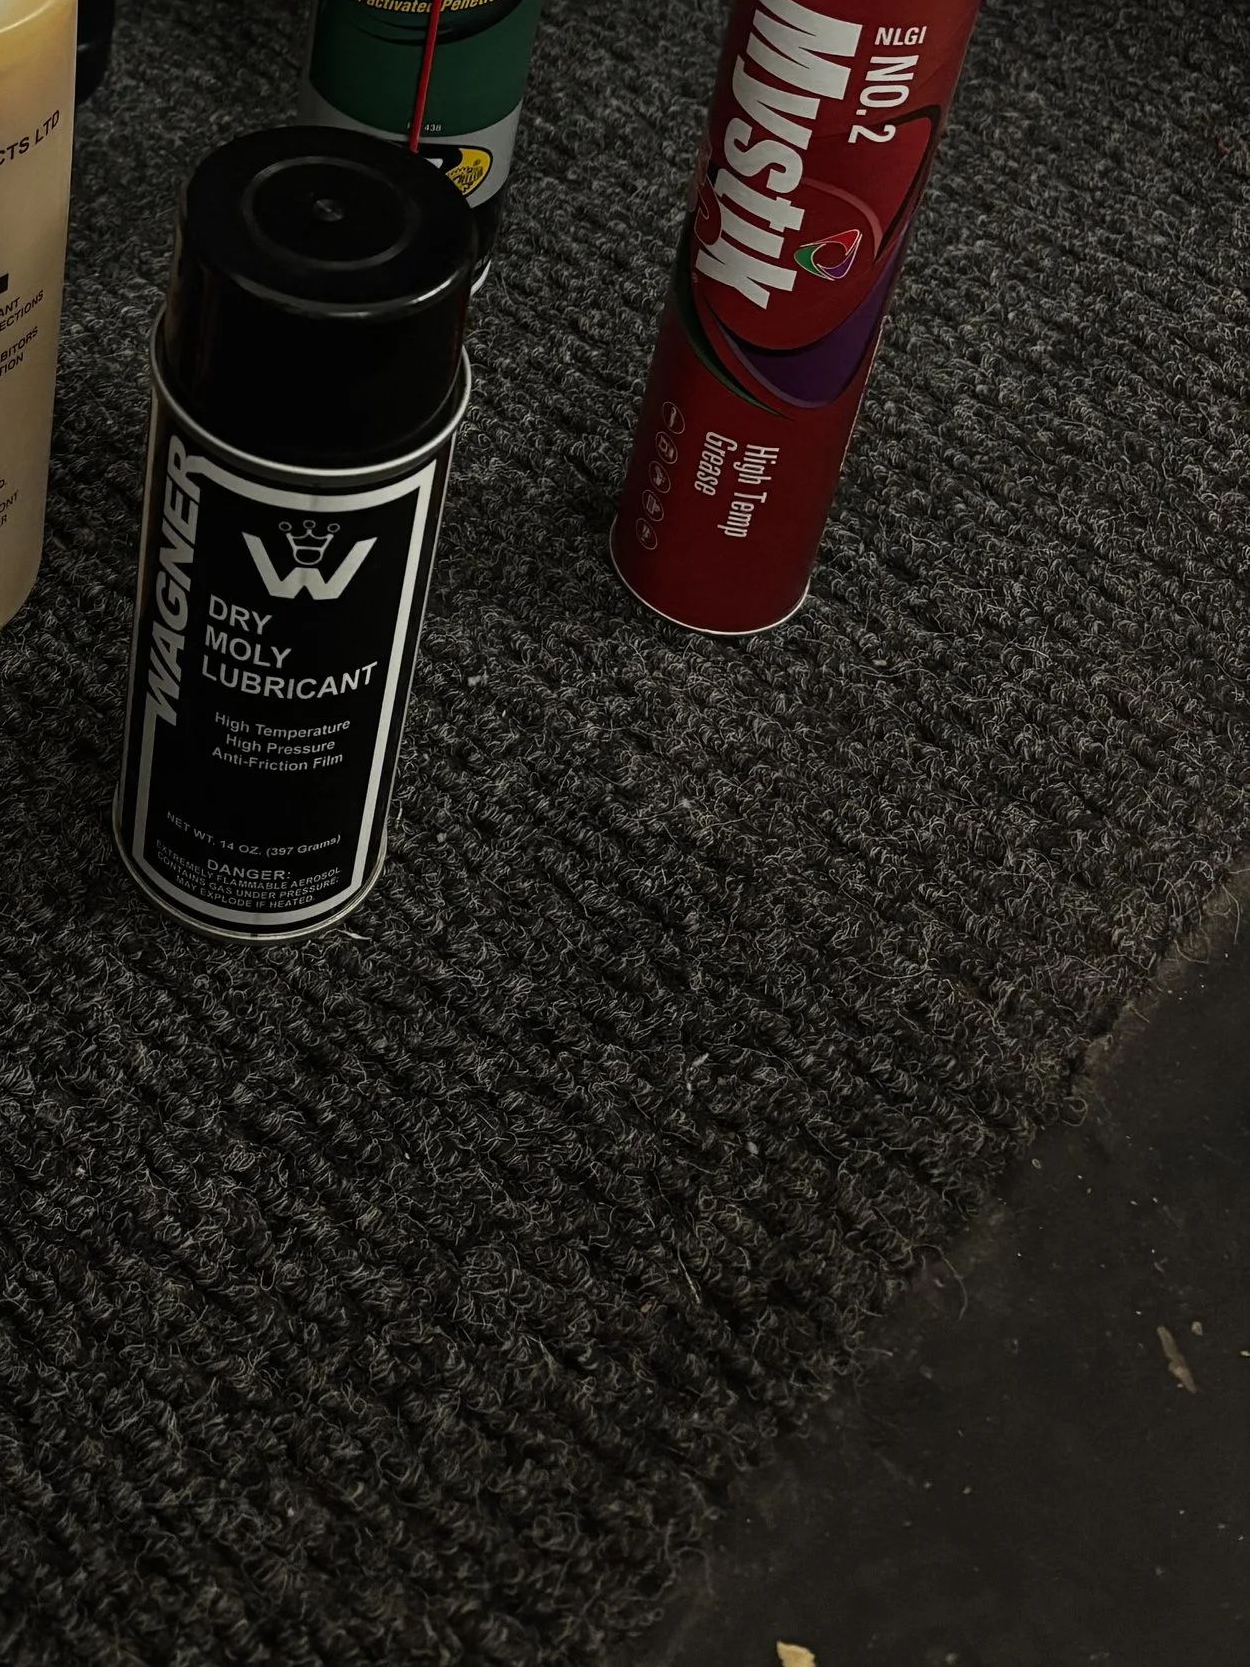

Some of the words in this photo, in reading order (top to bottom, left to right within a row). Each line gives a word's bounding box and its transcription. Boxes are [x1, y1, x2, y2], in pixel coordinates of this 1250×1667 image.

[874, 25, 928, 47] NLGI
[855, 54, 920, 117] NO.
[35, 109, 61, 145] LTD
[847, 123, 897, 145] 2
[693, 431, 739, 497] Grease
[732, 443, 780, 486] High
[716, 491, 768, 538] Temp
[147, 434, 201, 727] WAGNER
[208, 593, 273, 635] DRY
[204, 624, 292, 669] MOLY
[201, 654, 379, 701] LUBRICANT
[214, 710, 251, 734] High
[255, 719, 351, 742] Temperature
[226, 733, 262, 753] High
[266, 740, 336, 756] Pressure
[211, 745, 308, 772] Anti-Friction
[313, 752, 344, 769] Film
[167, 810, 190, 833] NET
[193, 829, 216, 846] WT.
[220, 839, 235, 851] 14
[239, 844, 262, 856] OZ.
[266, 846, 294, 859] (397
[297, 833, 342, 855] Grams)
[155, 838, 214, 879] EXTREMELY
[216, 874, 287, 891] FLAMMABLE
[156, 851, 206, 887] CONTAINS
[209, 883, 233, 895] GAS
[236, 889, 276, 900] UNDER
[206, 857, 292, 881] DANGER:
[175, 874, 198, 892] MAY
[200, 888, 251, 909] EXPLODE
[255, 900, 266, 909] IF
